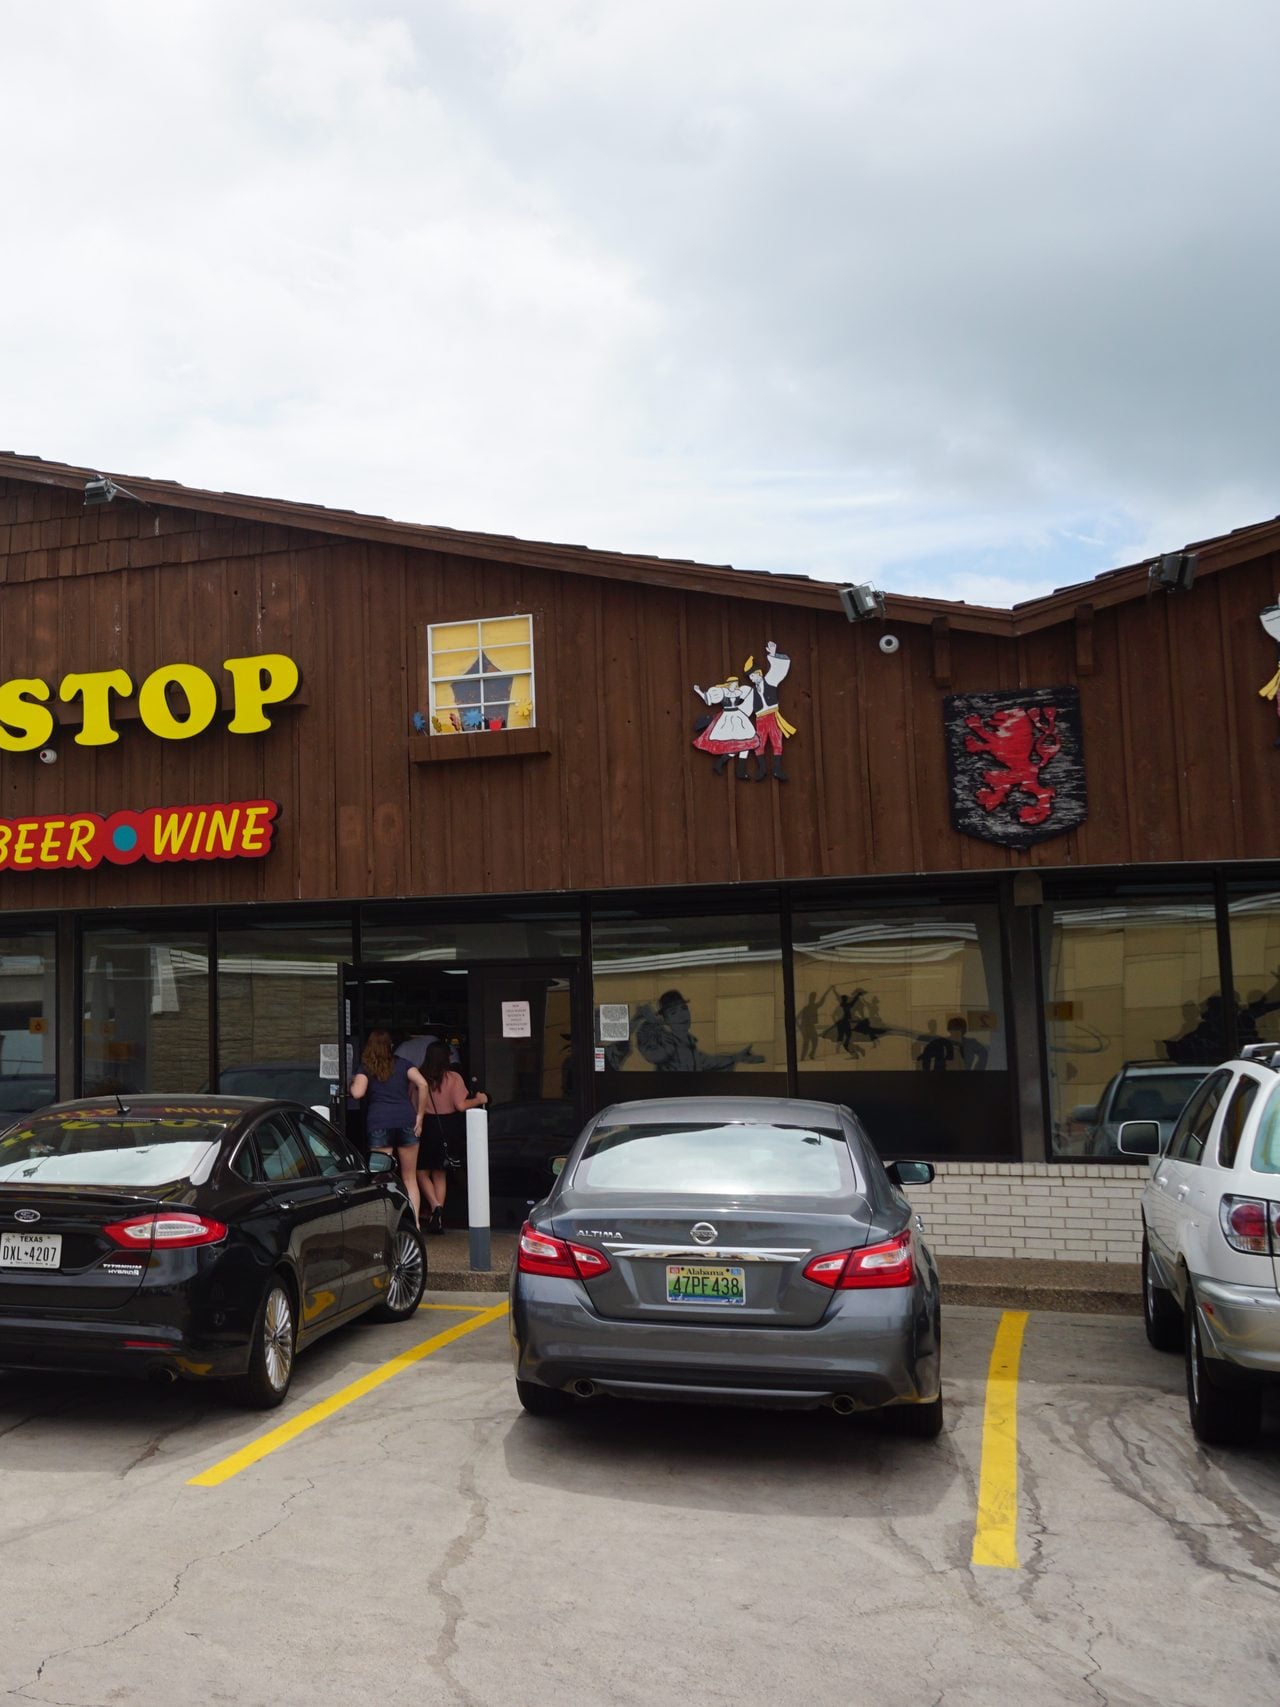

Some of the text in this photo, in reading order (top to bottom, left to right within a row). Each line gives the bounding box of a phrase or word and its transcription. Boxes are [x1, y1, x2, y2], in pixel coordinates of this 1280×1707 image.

[153, 806, 269, 856] WINE
[576, 1229, 623, 1239] ALTIMA
[686, 1267, 724, 1276] Alabama
